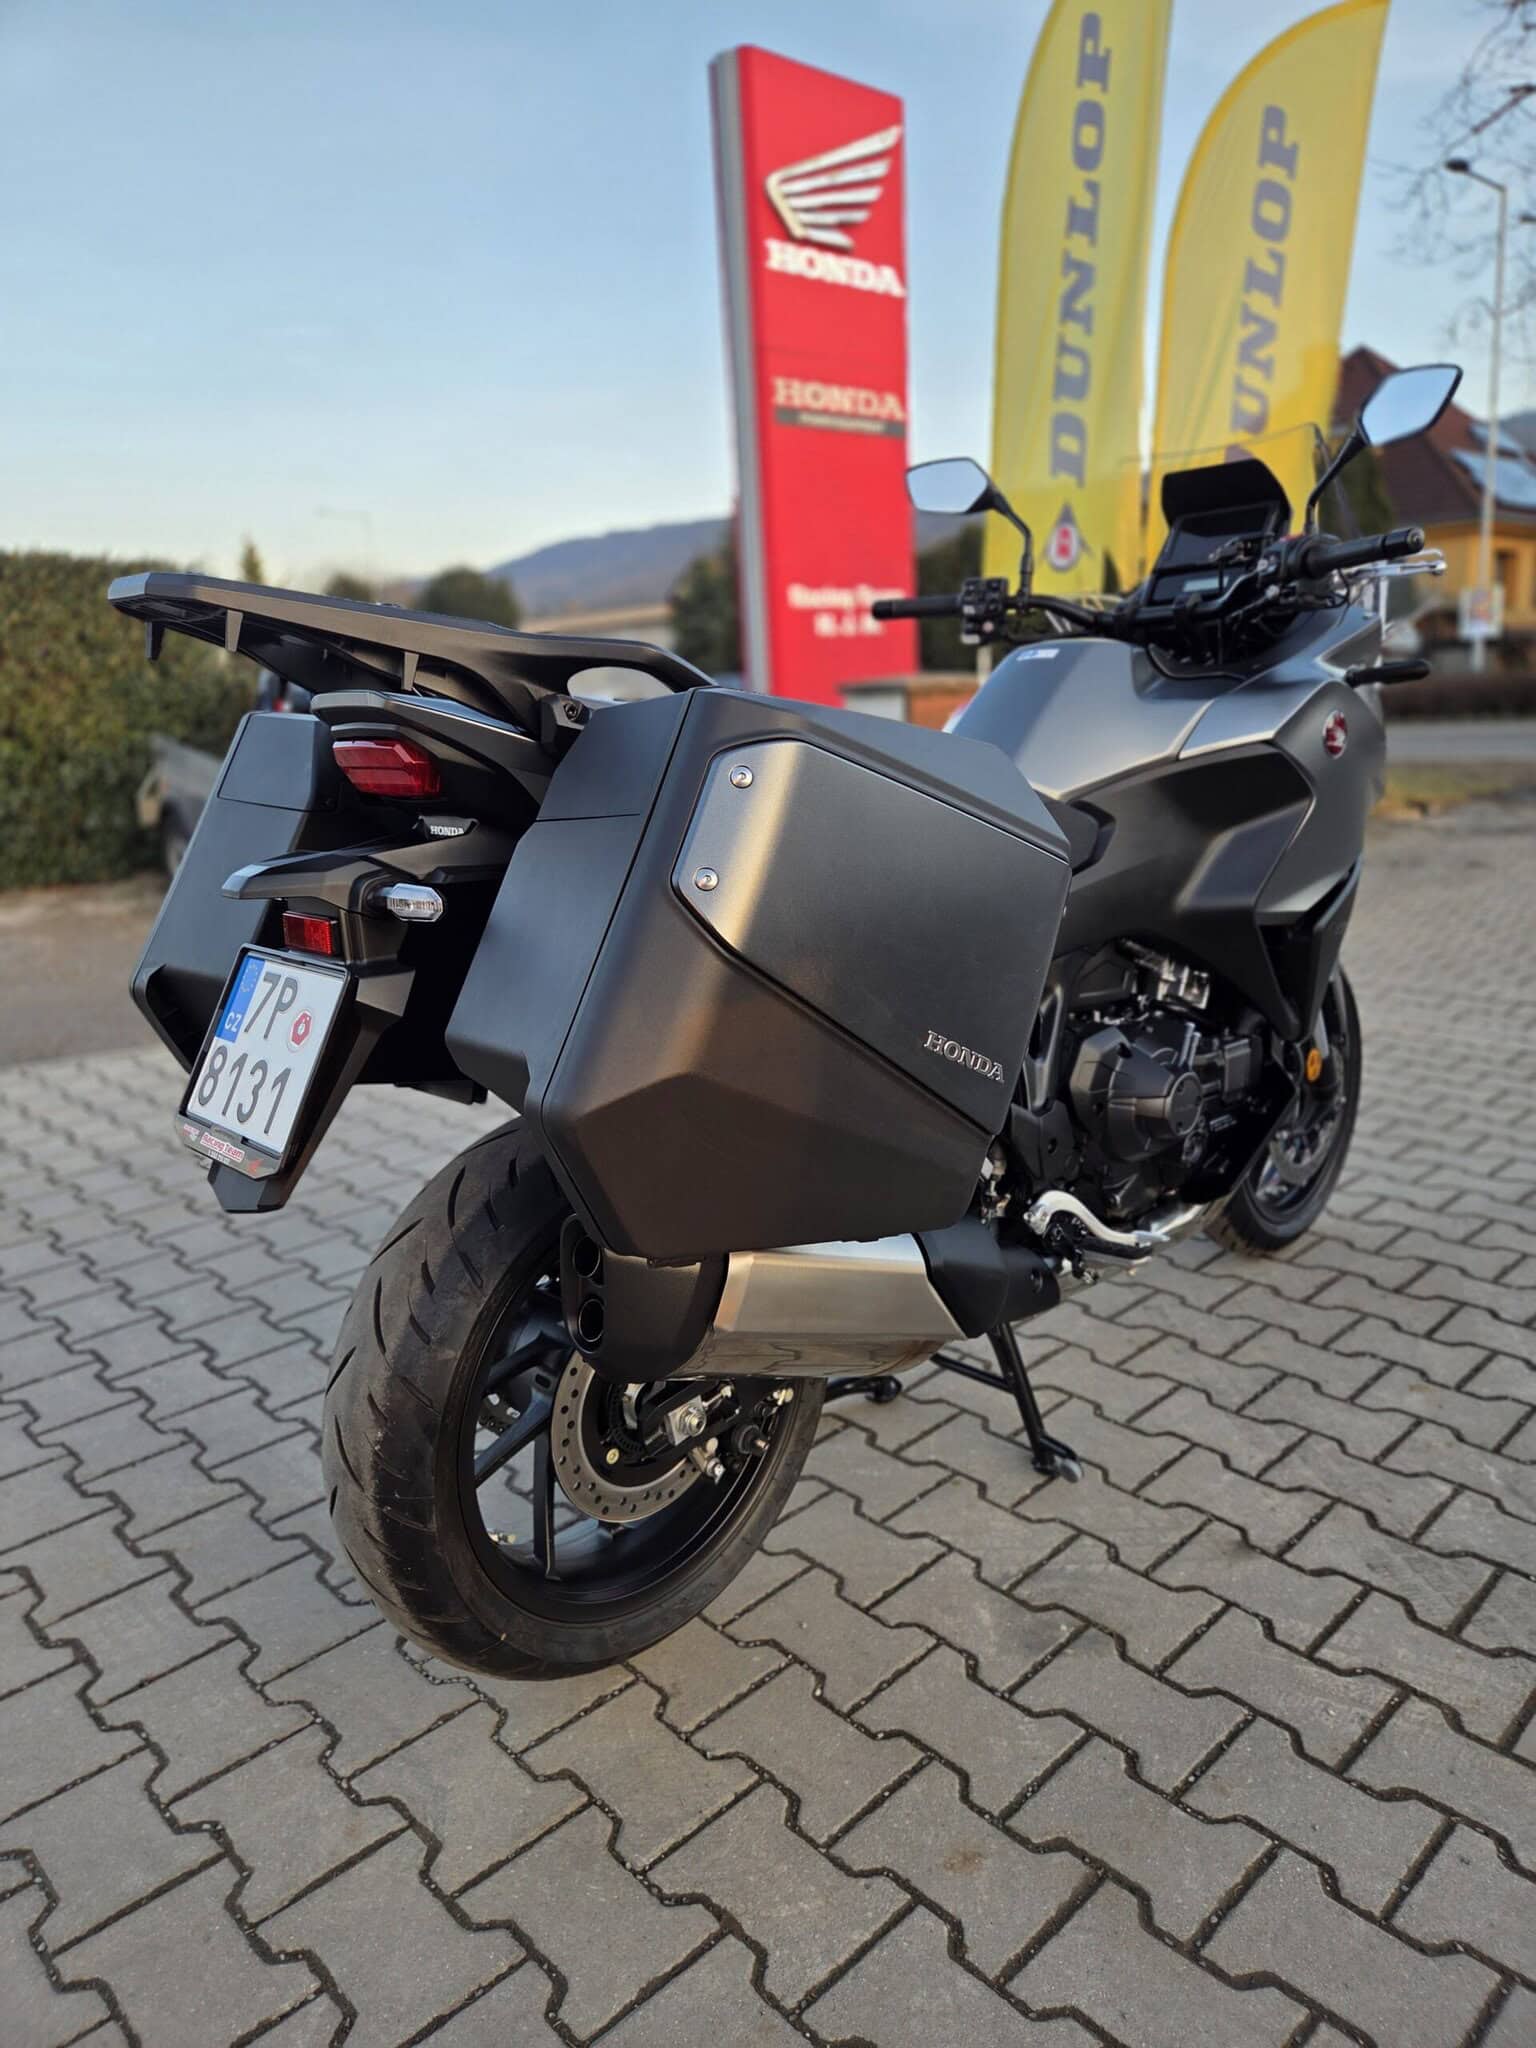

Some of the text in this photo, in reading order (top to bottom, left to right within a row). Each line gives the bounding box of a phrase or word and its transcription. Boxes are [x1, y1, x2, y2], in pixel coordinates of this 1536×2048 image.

[765, 239, 906, 298] HONDA
[1050, 12, 1111, 488] DUNLOP
[773, 377, 905, 421] HONDA
[430, 825, 464, 837] HONDA
[225, 1011, 242, 1033] CZ
[243, 971, 298, 1040] 7P
[924, 1030, 1004, 1083] HONDA
[198, 1045, 291, 1134] 8131
